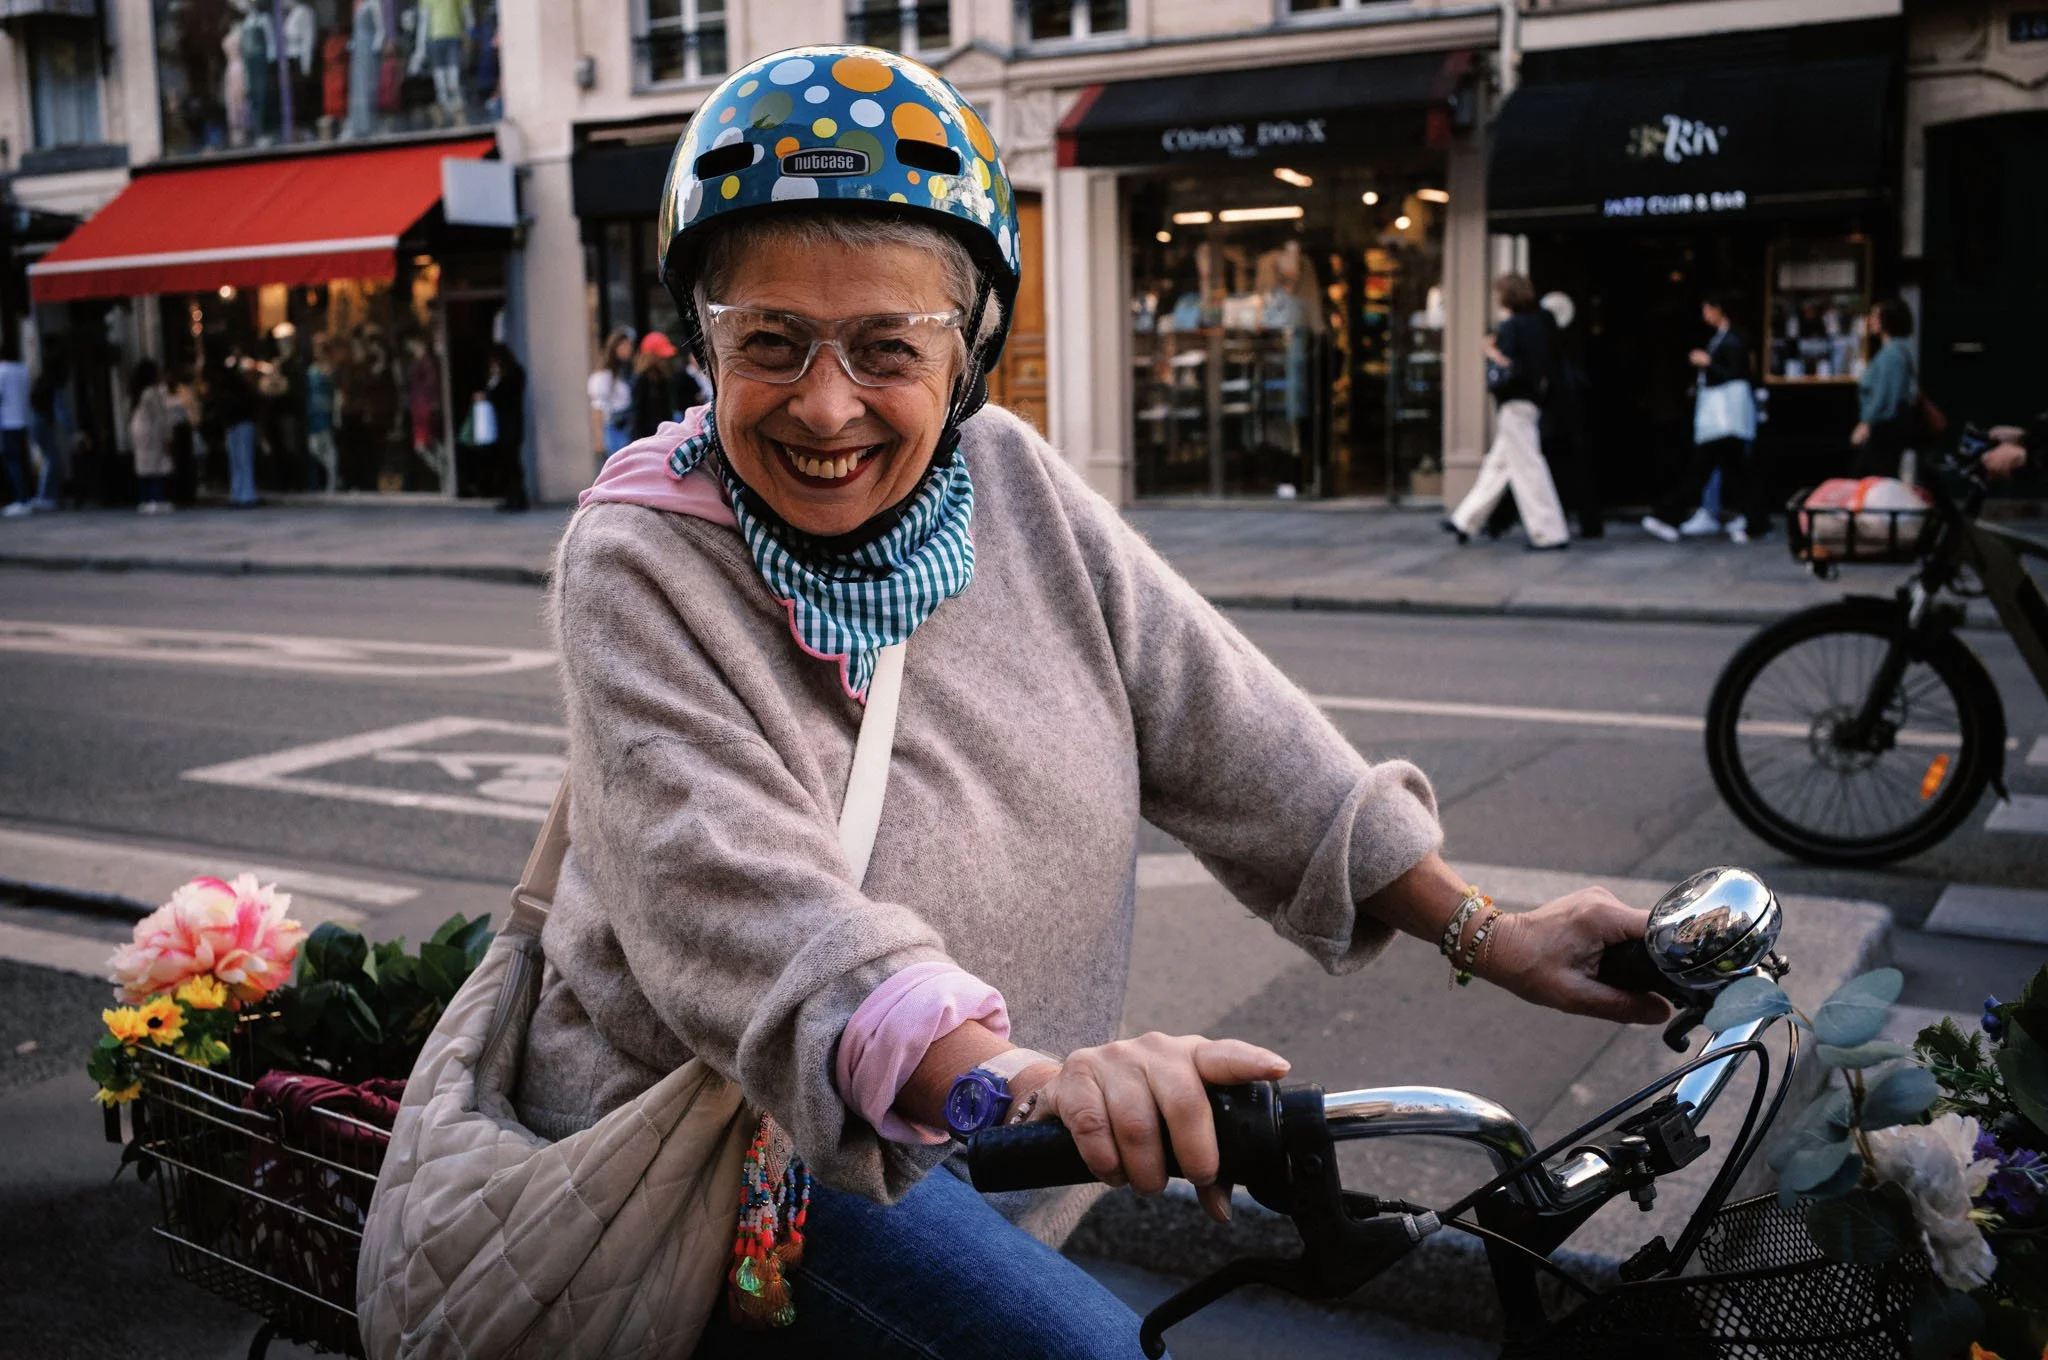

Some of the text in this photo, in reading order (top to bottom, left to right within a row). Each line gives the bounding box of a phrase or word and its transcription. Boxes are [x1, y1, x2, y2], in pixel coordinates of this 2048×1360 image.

[794, 154, 855, 171] nutcase
[1603, 196, 1645, 217] JAZZ
[1646, 194, 1693, 215] CLUB
[1710, 190, 1746, 211] BAR
